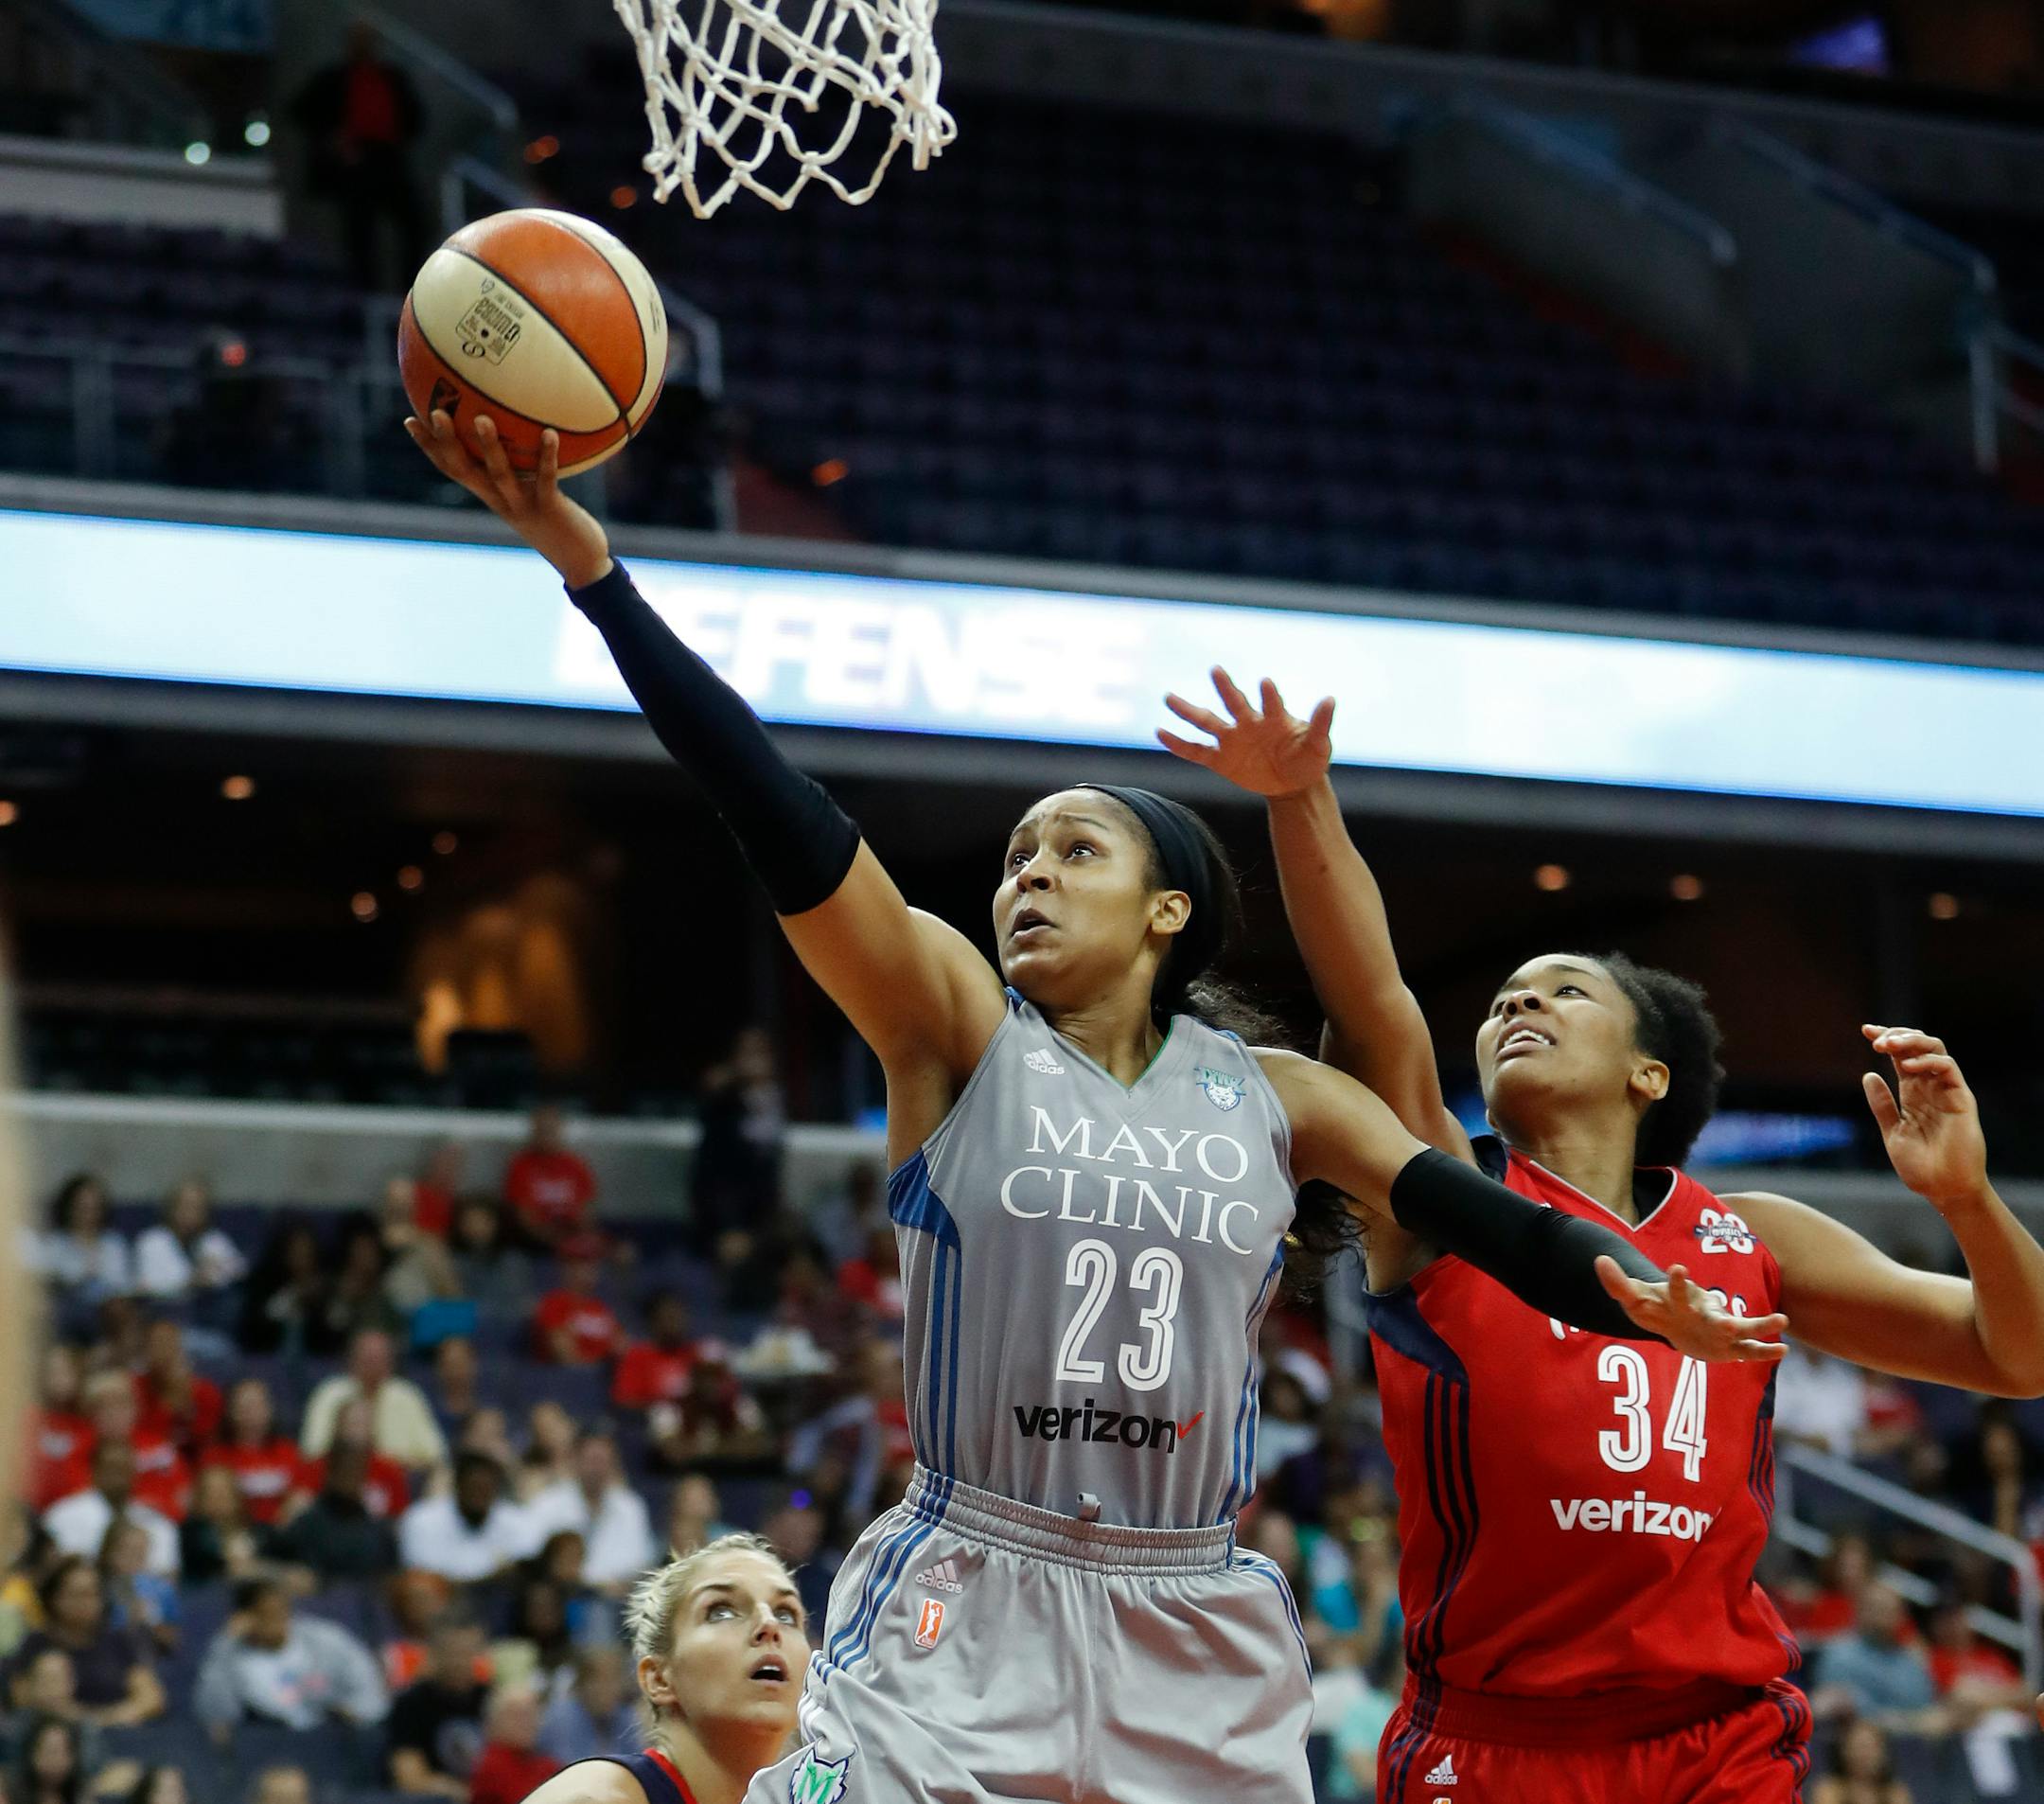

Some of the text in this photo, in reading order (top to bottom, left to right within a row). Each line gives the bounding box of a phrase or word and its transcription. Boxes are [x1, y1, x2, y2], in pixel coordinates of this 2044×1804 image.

[1026, 1105, 1249, 1183] MAYO
[1000, 1166, 1260, 1256] CLINIC
[1055, 1238, 1184, 1392] 23
[1013, 1398, 1176, 1454] verizon
[1597, 1344, 1707, 1483] 34
[915, 1572, 963, 1594] adidas
